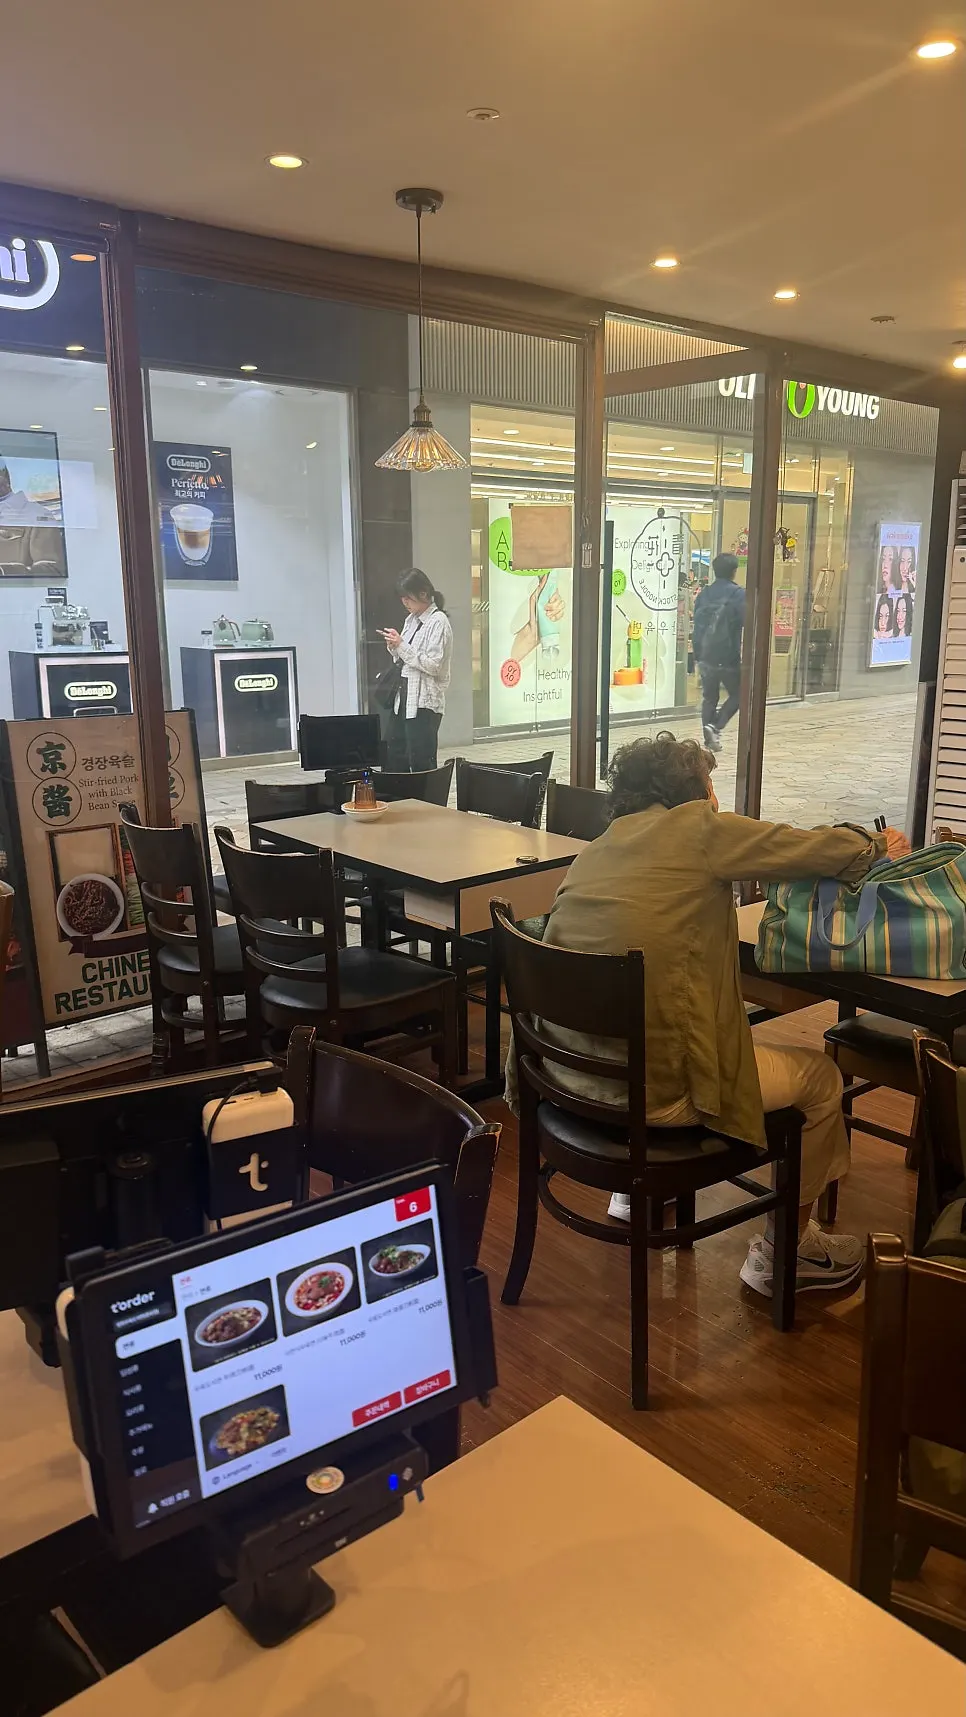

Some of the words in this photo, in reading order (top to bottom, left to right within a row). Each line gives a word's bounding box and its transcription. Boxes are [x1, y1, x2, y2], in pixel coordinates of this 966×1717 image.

[817, 386, 880, 420] YOUNG
[538, 668, 571, 681] Healthy
[523, 688, 562, 704] Insghtful
[78, 776, 118, 788] Stir-fried
[119, 773, 140, 785] Pork
[88, 788, 108, 799] with
[110, 785, 133, 797] Black
[88, 802, 110, 811] Bean
[54, 974, 152, 1014] RESTAU
[409, 1201, 418, 1213] 6
